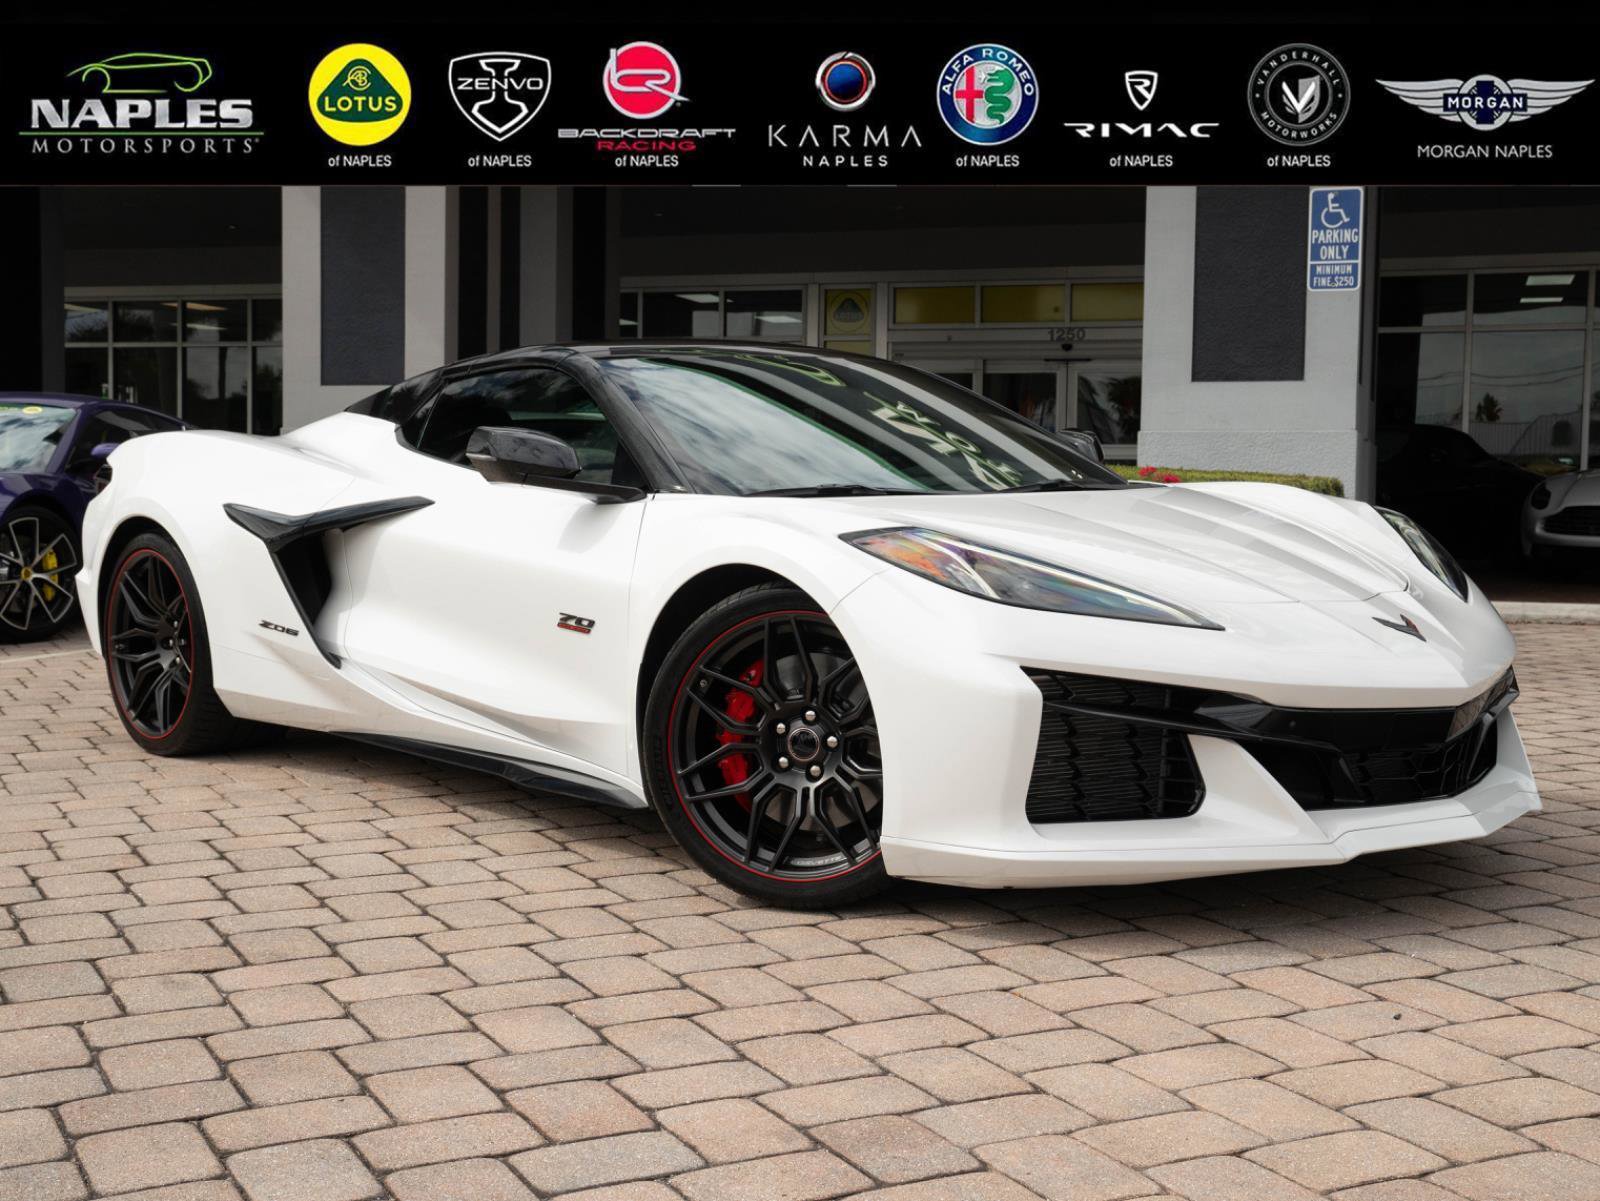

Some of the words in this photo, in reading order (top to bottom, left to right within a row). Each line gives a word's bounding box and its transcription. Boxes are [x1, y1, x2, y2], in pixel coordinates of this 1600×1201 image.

[1311, 228, 1359, 244] PARKING
[1320, 245, 1349, 260] ONLY
[1316, 264, 1353, 275] MINIMUM
[1313, 276, 1331, 287] FINE
[1334, 276, 1354, 287] $250
[1048, 328, 1086, 341] 1250
